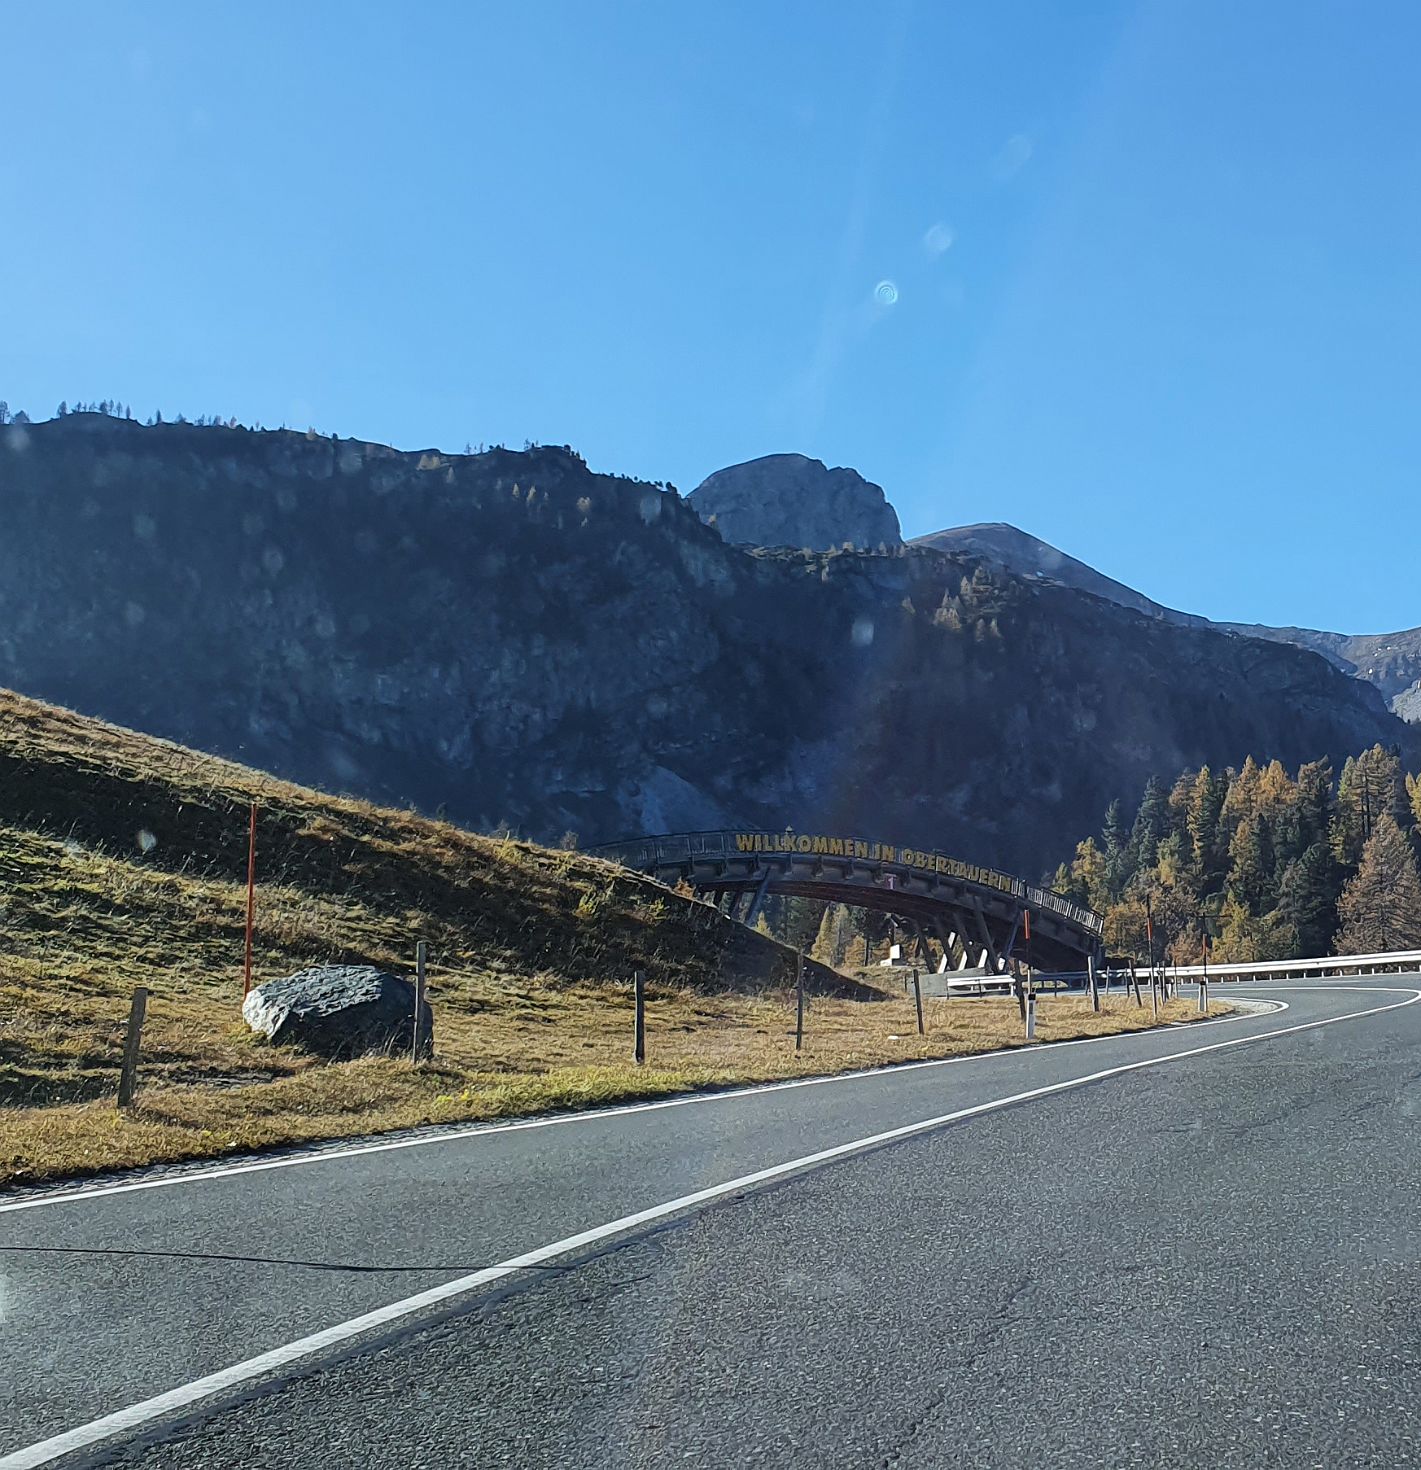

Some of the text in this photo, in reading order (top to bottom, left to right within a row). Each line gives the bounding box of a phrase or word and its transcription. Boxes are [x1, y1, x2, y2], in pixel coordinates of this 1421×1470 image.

[735, 834, 1012, 892] WILLKOMMEN IN OBERTAUERN
